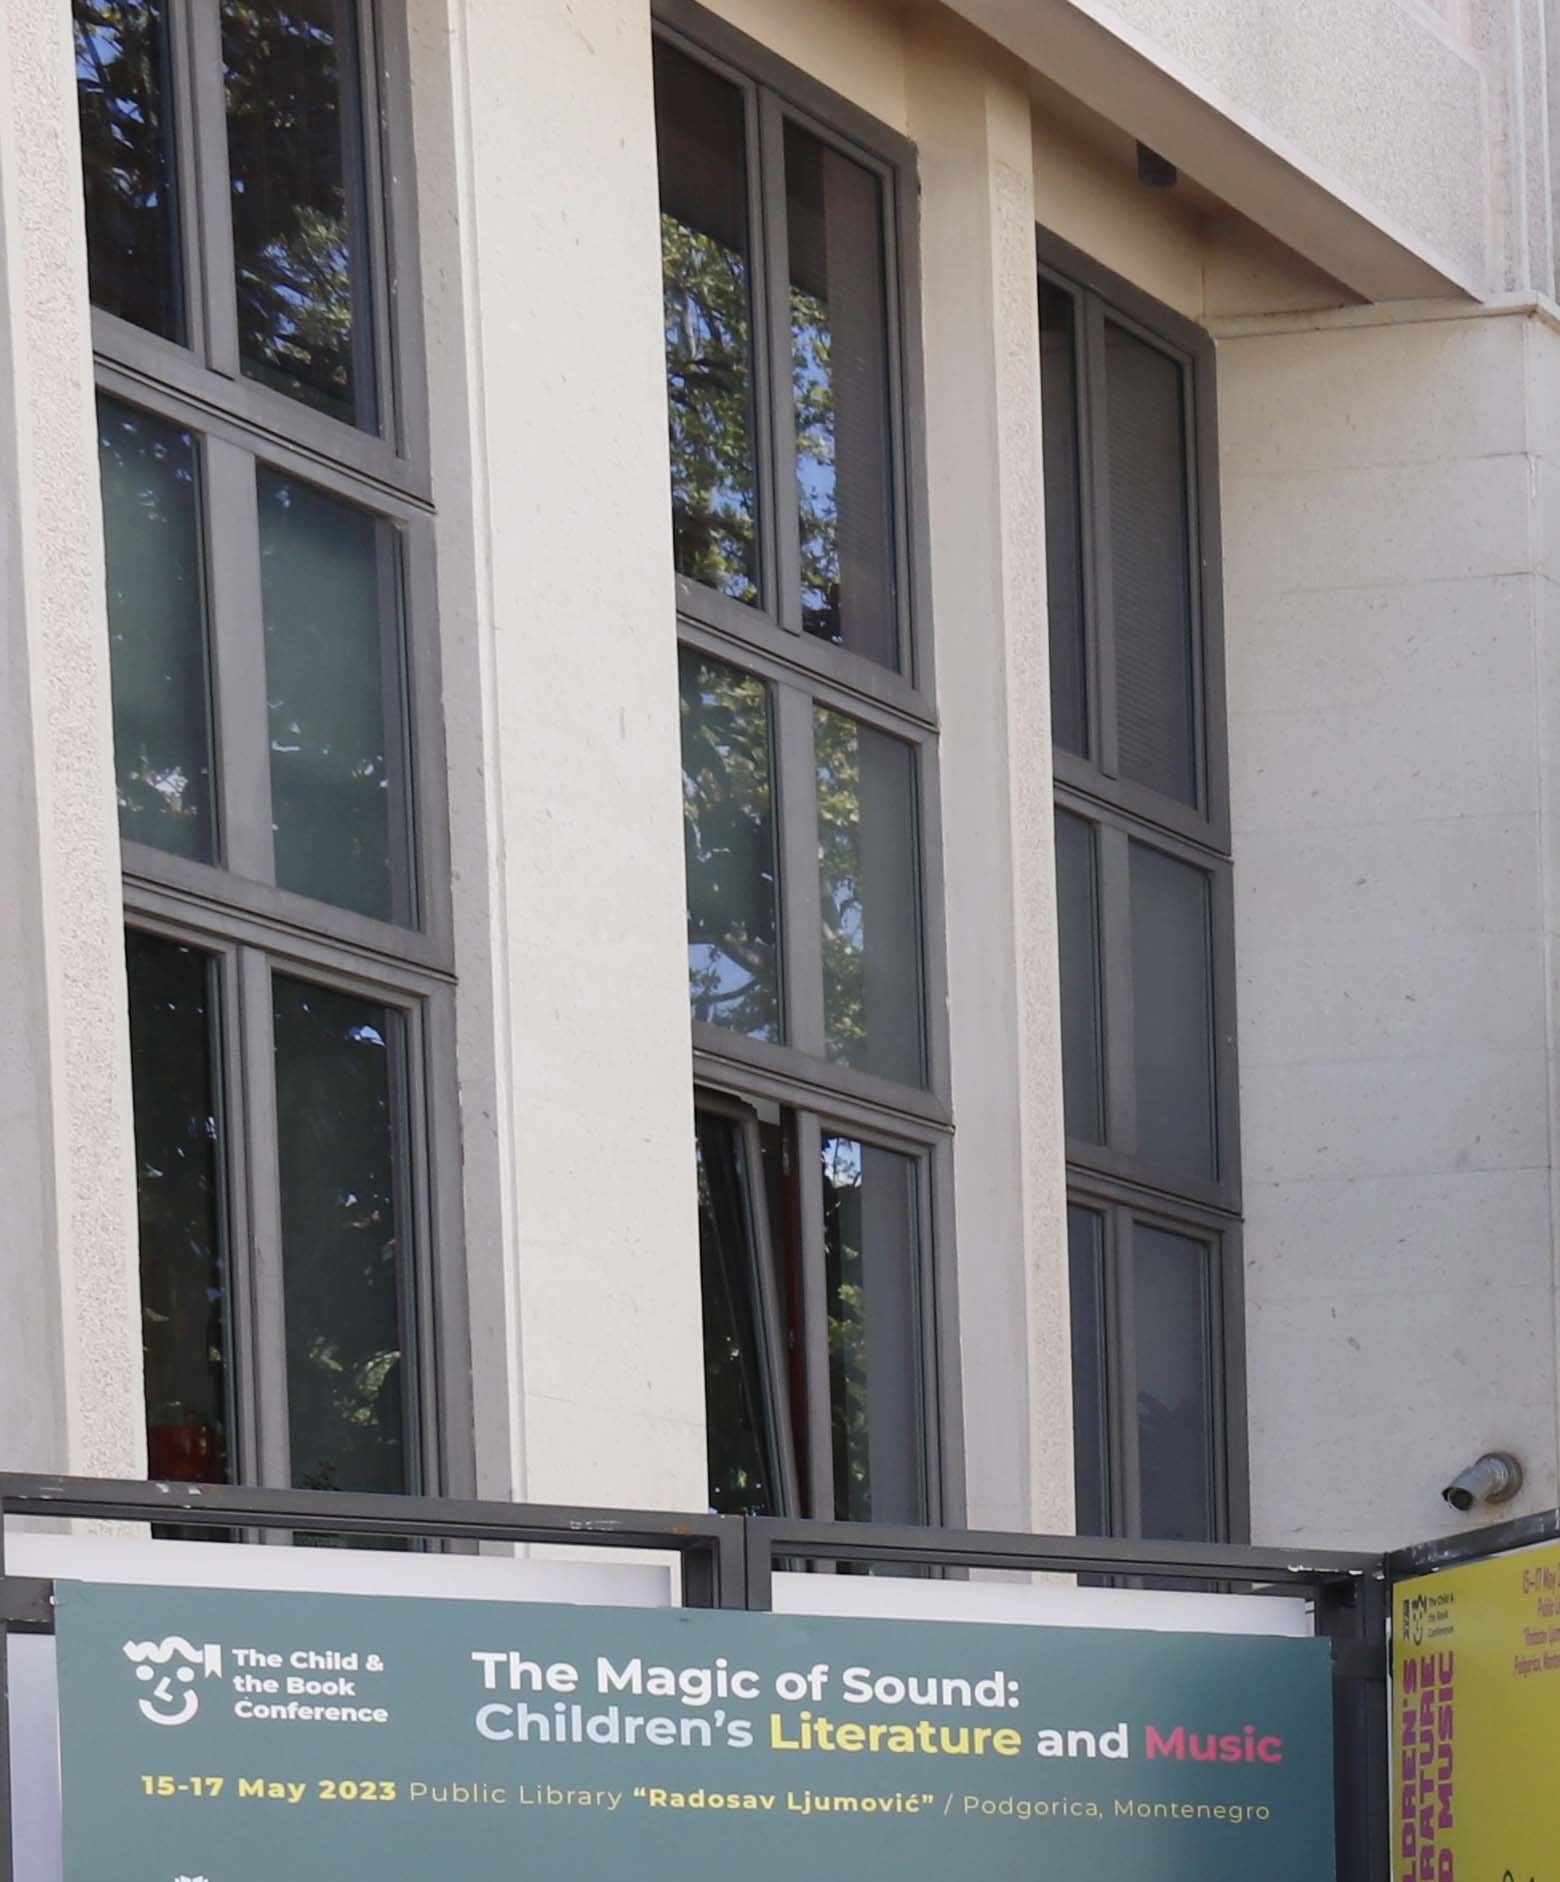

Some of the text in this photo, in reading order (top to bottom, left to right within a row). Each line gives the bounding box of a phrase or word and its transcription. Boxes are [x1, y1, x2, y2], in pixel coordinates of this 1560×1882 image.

[231, 1648, 385, 1673] The Child &
[233, 1674, 357, 1697] the Book
[471, 1651, 1020, 1709] The Magic of Sound:
[233, 1699, 389, 1723] Conference
[475, 1702, 1283, 1764] Children’s Literature and Music
[1437, 1650, 1454, 1829] MUSIC
[141, 1774, 225, 1798] 15-17
[238, 1777, 307, 1804] May
[318, 1780, 397, 1802] 2023
[409, 1782, 506, 1805] Public
[519, 1783, 624, 1810] Library
[633, 1786, 776, 1810] “Radosav
[963, 1795, 1104, 1820] Podgorica,
[1113, 1799, 1270, 1824] Montenegro
